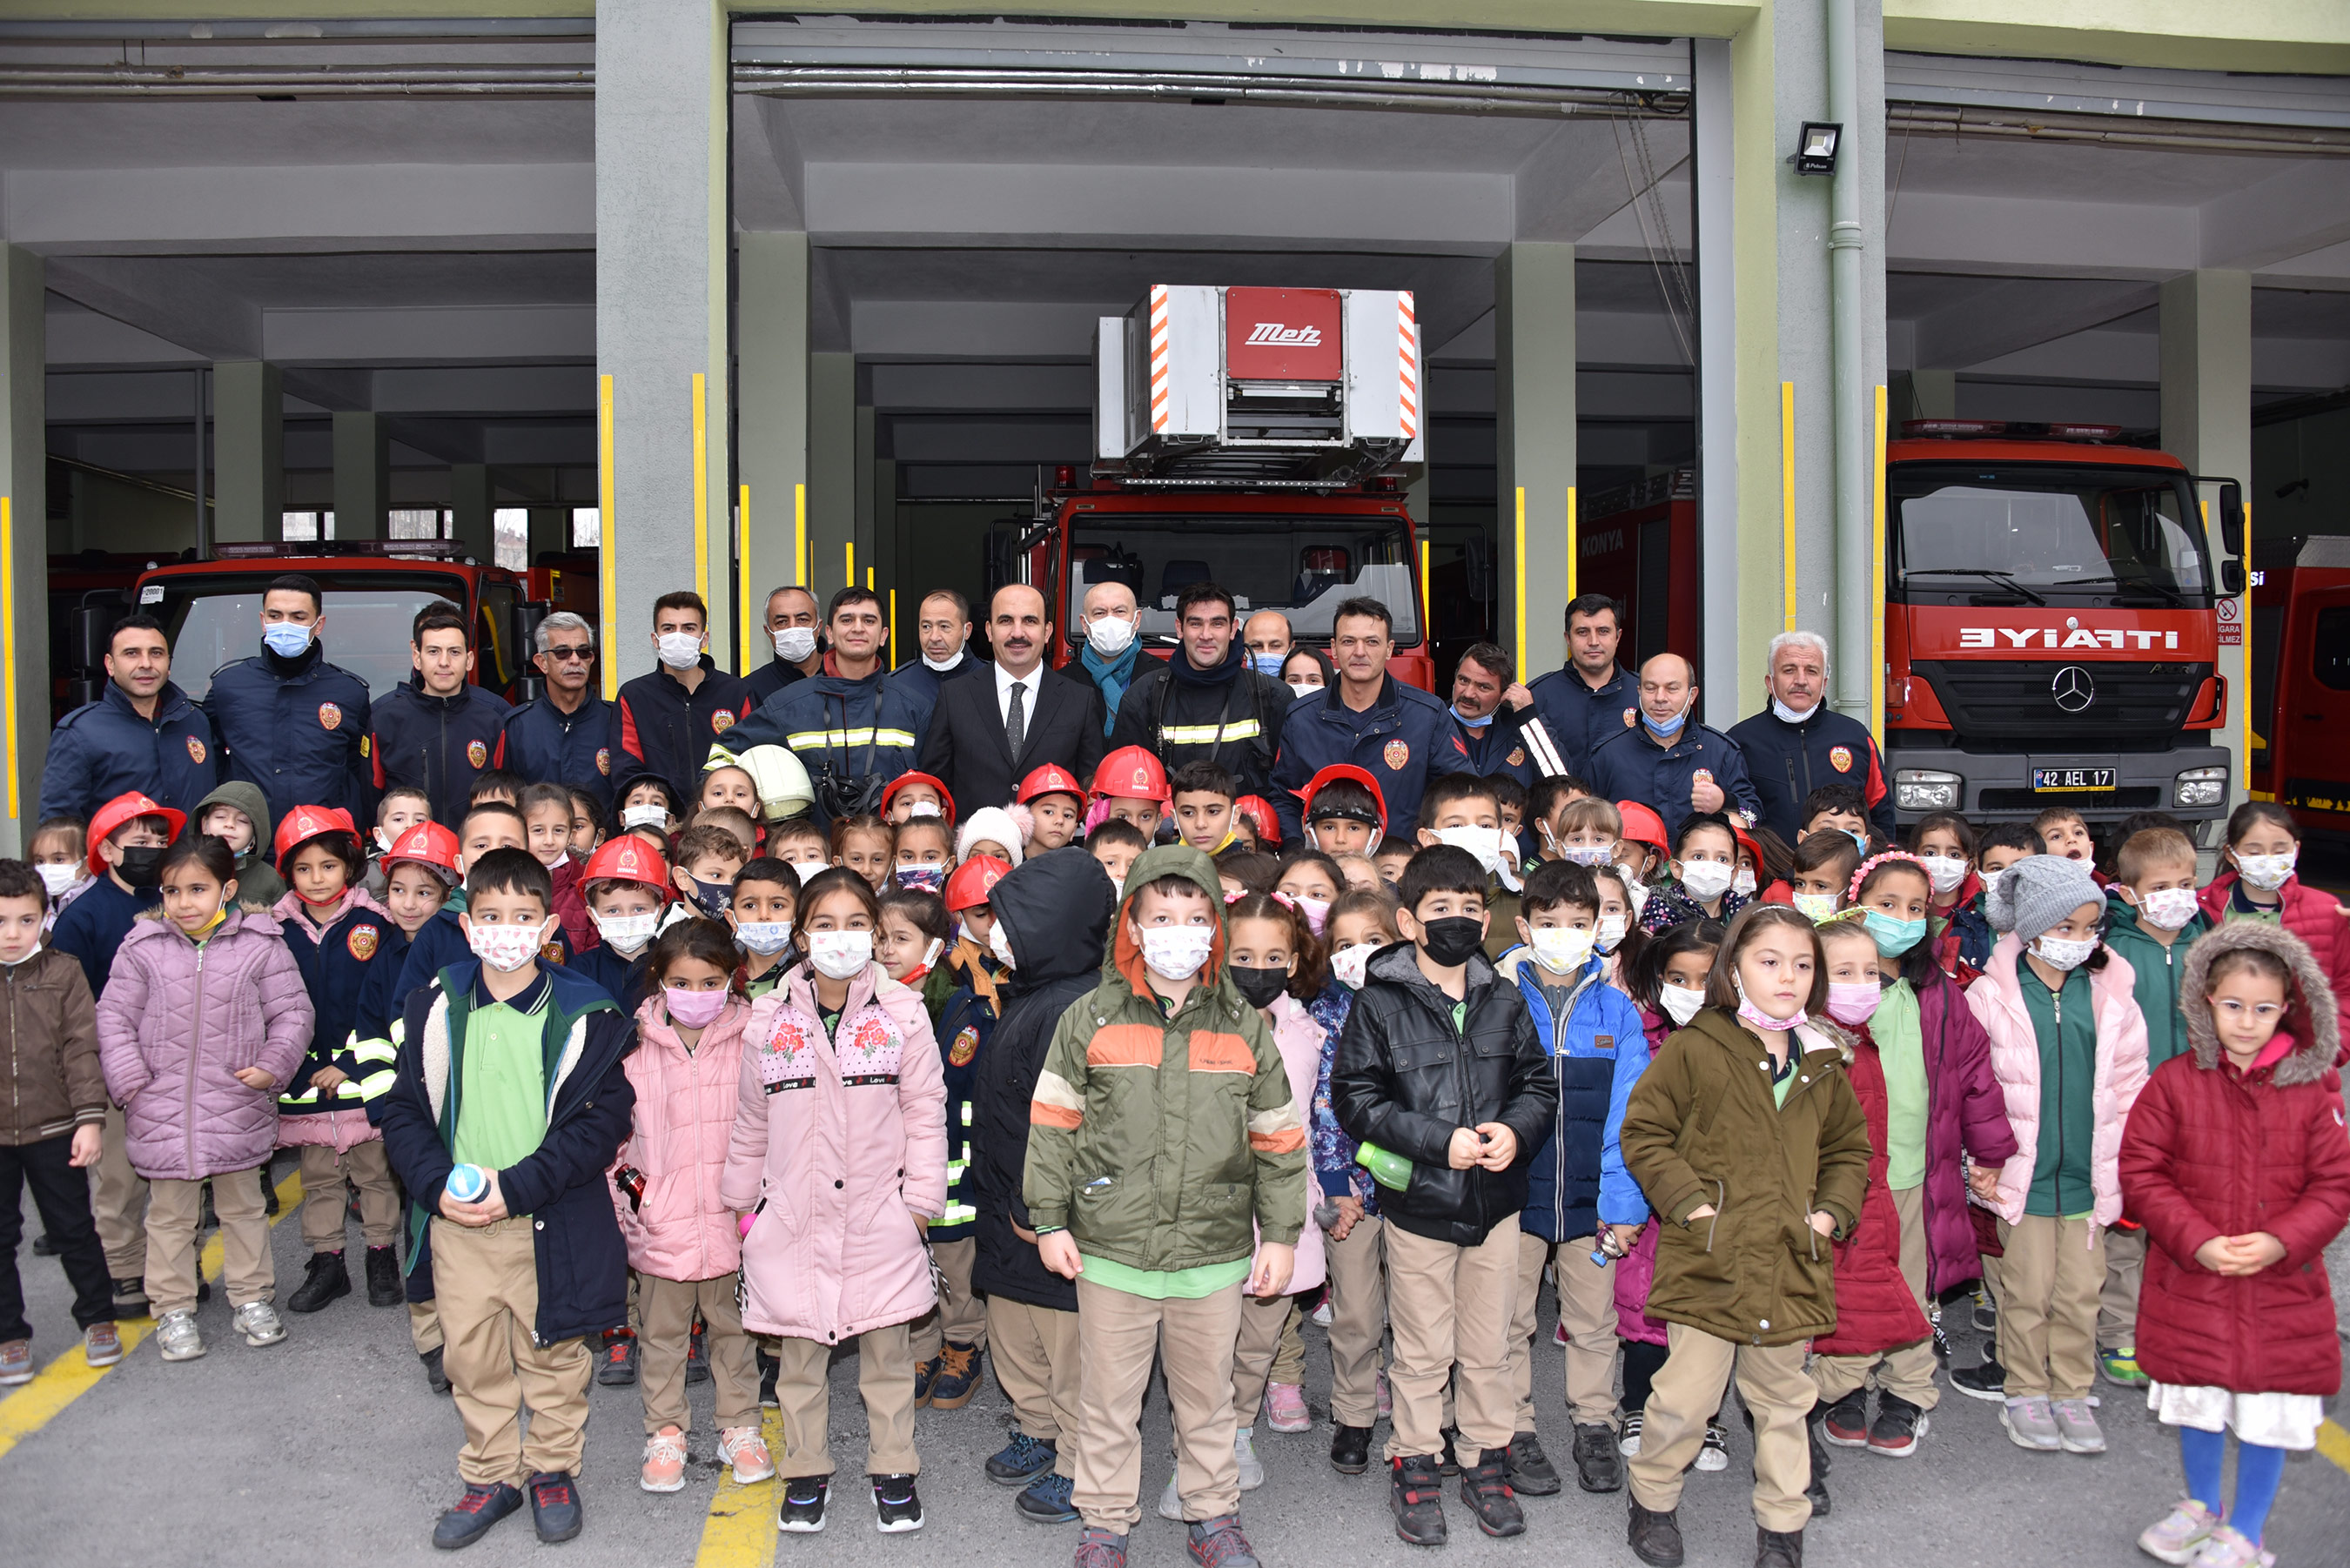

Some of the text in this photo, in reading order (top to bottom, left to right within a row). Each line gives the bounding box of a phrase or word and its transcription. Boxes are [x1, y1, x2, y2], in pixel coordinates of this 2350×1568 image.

[1245, 323, 1322, 346] Metz
[1581, 529, 1624, 557] KONYA
[2218, 623, 2240, 633] İGARA
[2218, 633, 2240, 643] İLMEZ
[2043, 771, 2109, 786] 42 AEL 17
